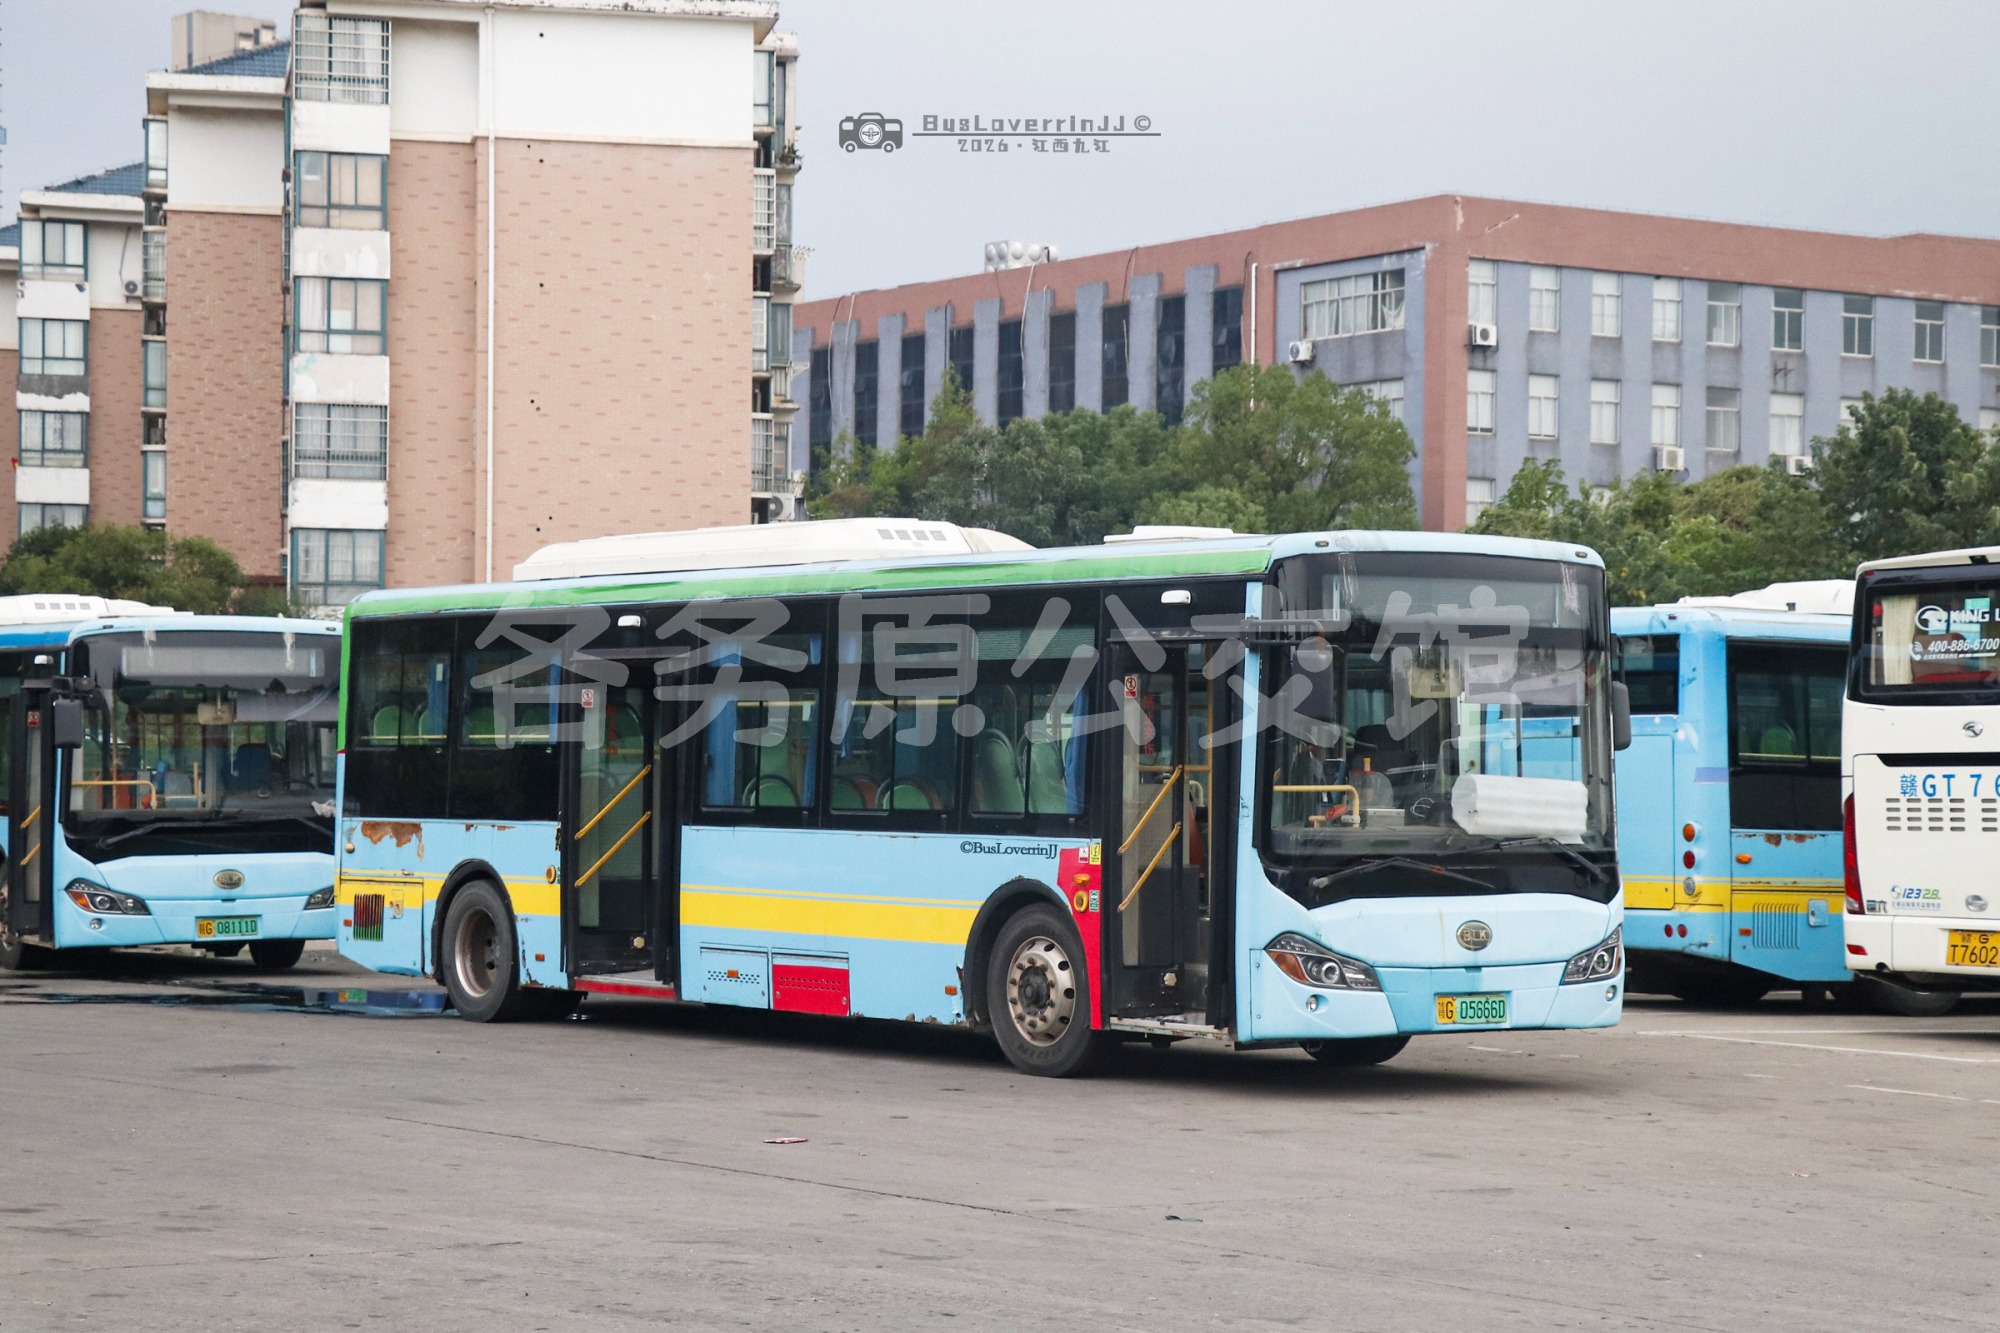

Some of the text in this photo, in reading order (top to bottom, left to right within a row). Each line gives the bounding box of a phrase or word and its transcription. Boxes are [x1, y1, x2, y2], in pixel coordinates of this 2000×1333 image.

[1949, 609, 1990, 623] KING
[1928, 638, 2000, 653] 400-886-6700
[1902, 887, 1942, 899] 12328
[1950, 944, 1999, 964] T7602
[1460, 1000, 1506, 1019] 05666D
